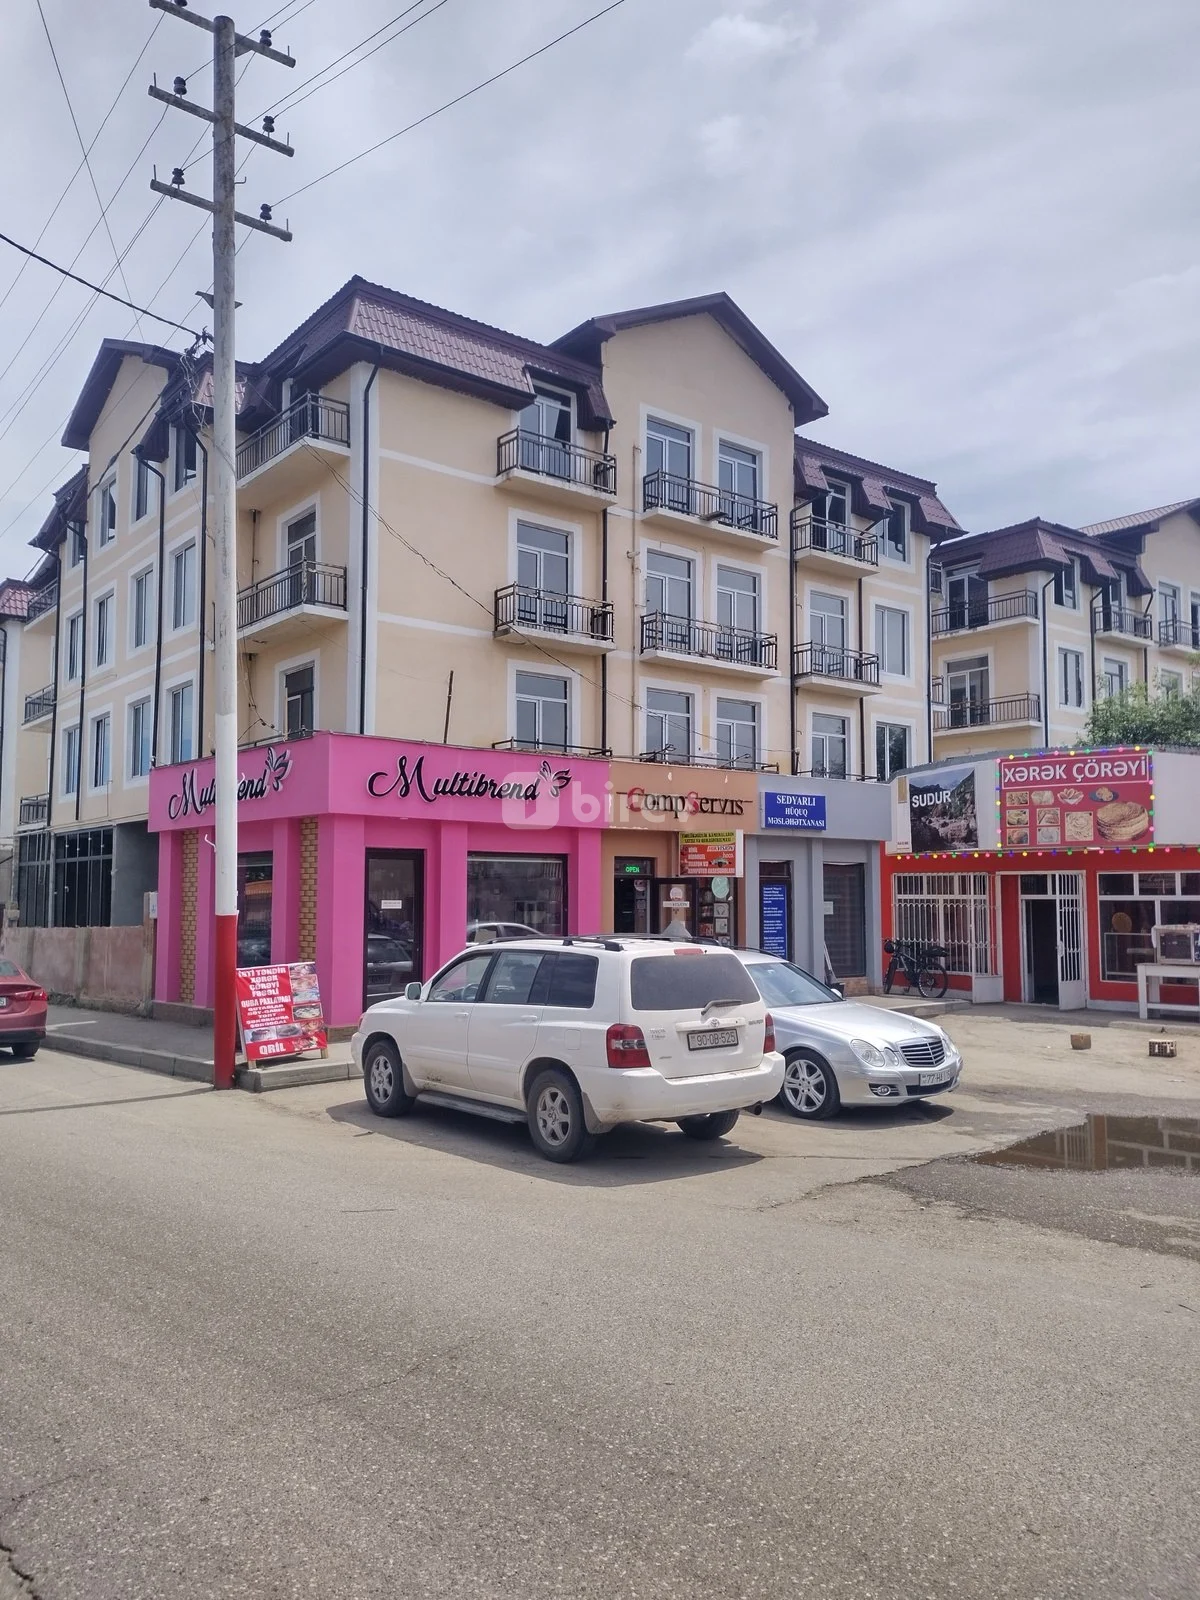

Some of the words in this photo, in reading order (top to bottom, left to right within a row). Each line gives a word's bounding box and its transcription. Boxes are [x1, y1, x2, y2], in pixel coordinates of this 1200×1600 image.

[1003, 764, 1067, 783] XƏRƏK
[1072, 757, 1147, 783] ÇÖRƏYİ
[367, 754, 541, 803] Multibrend
[168, 767, 270, 820] Mulend
[911, 791, 952, 808] SUDUR
[776, 794, 816, 806] SEDYARLI
[785, 806, 808, 817] HÜQUQ
[767, 816, 825, 827] MƏSLƏHƏTXANASI
[256, 967, 287, 976] TƏNDİR
[250, 975, 279, 984] XƏRƏK
[249, 981, 279, 991] ÇÖRƏYİ
[259, 1042, 286, 1055] QRİL
